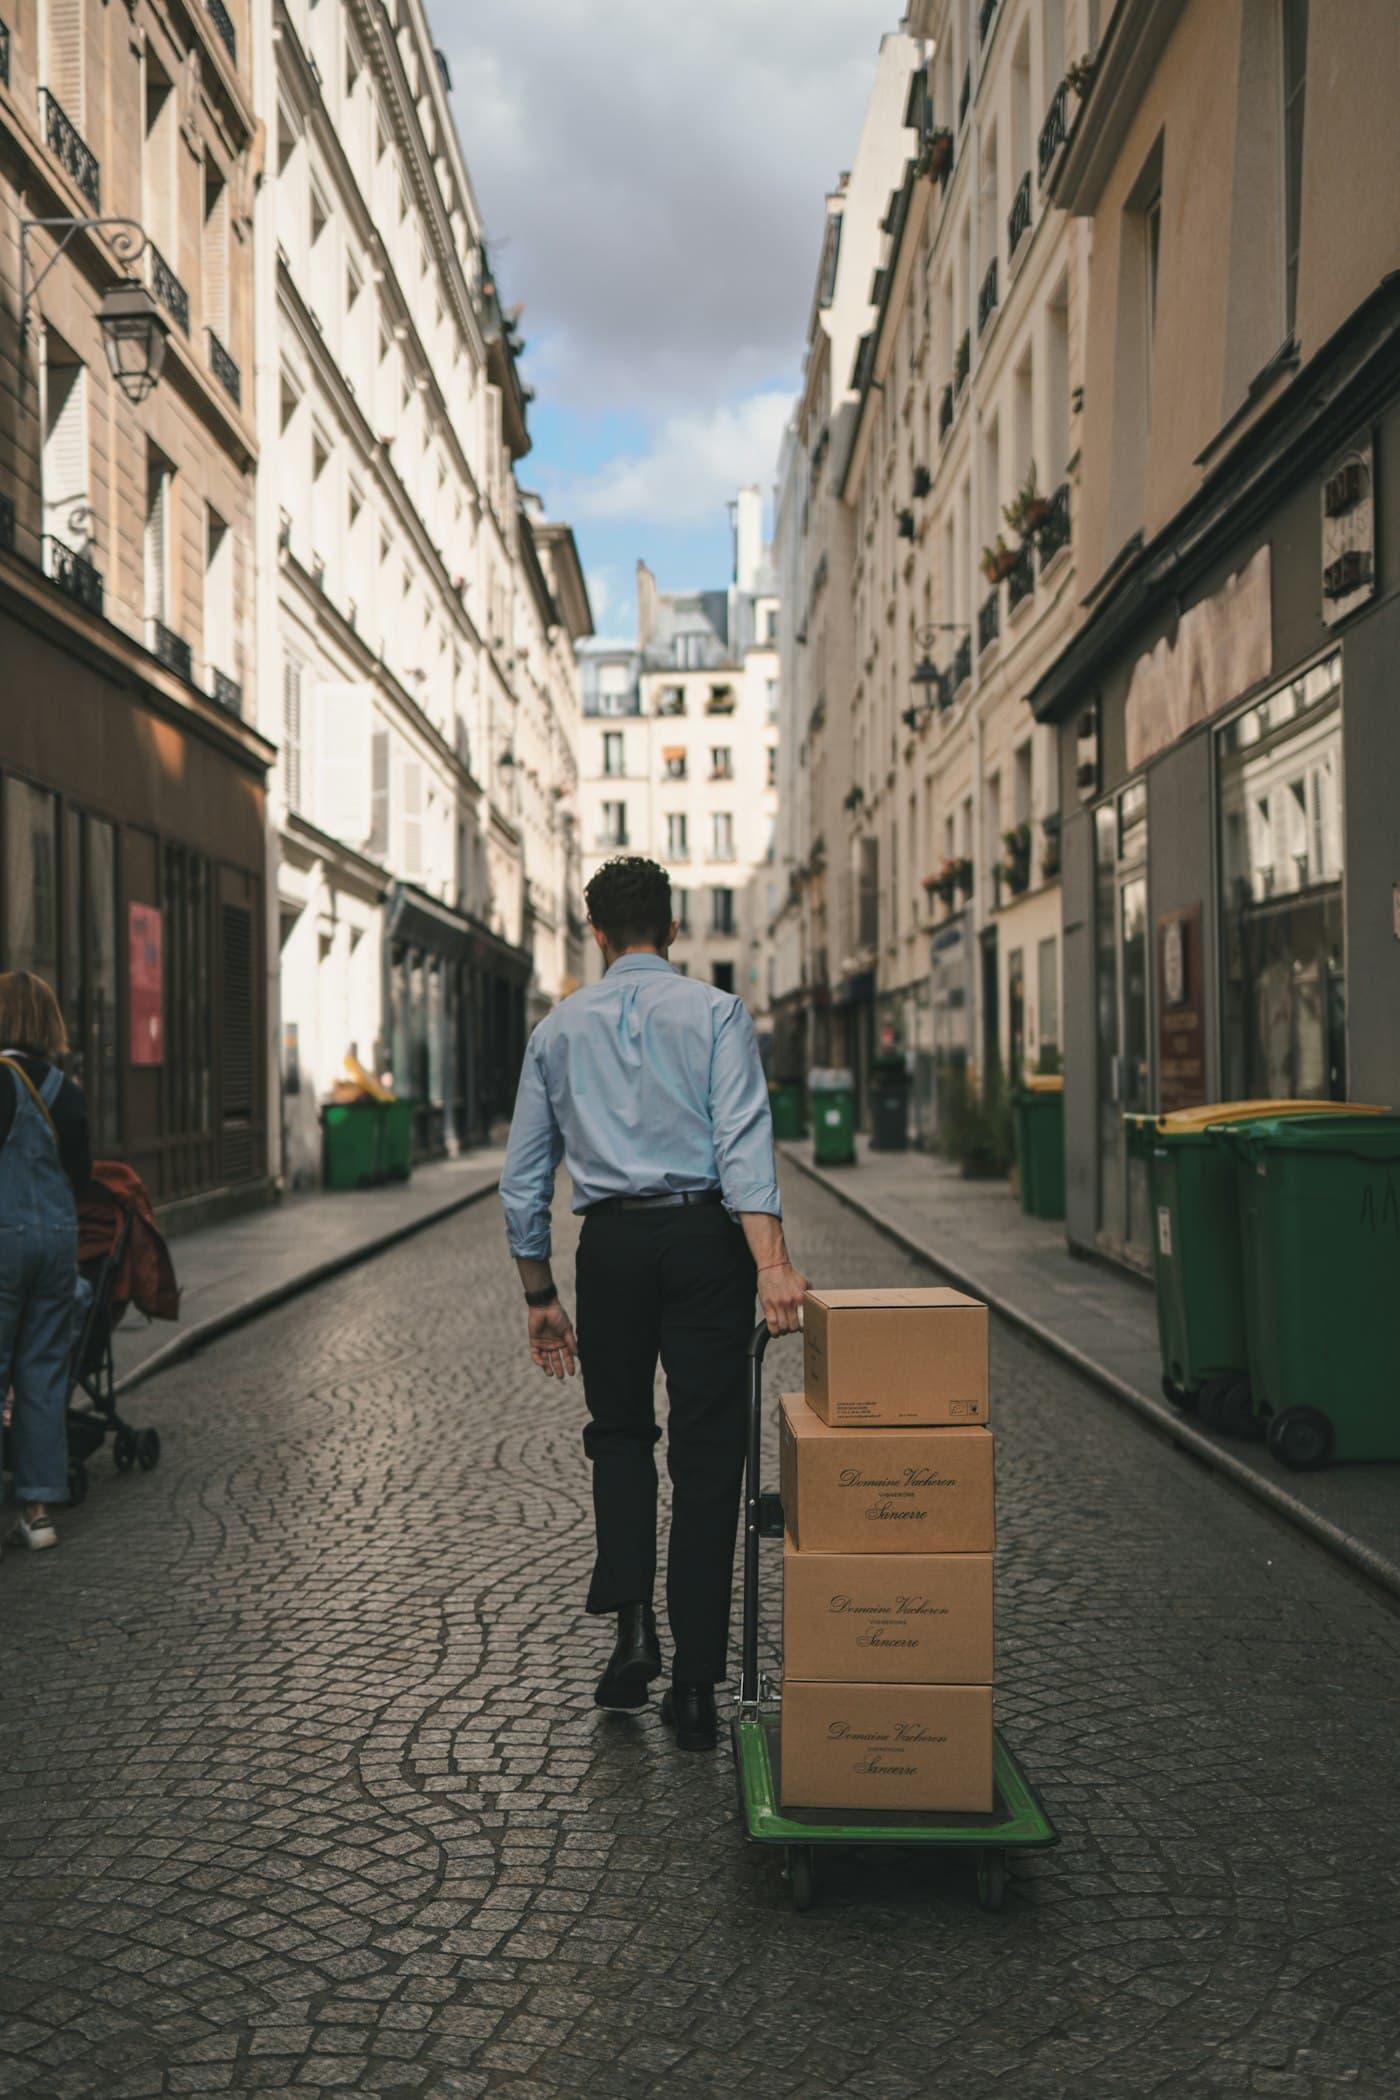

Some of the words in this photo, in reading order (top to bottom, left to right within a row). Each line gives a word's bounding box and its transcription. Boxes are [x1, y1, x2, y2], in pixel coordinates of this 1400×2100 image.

[837, 1468, 900, 1488] Domaine
[903, 1467, 956, 1487] Vacheron
[865, 1500, 927, 1521] Sancerre
[828, 1594, 892, 1614] Domaine
[895, 1595, 949, 1616] Vacheron
[855, 1627, 920, 1648] Sancerre
[826, 1720, 890, 1741] Domaine
[893, 1722, 948, 1743] Vacheron
[853, 1753, 918, 1776] Sancerre
